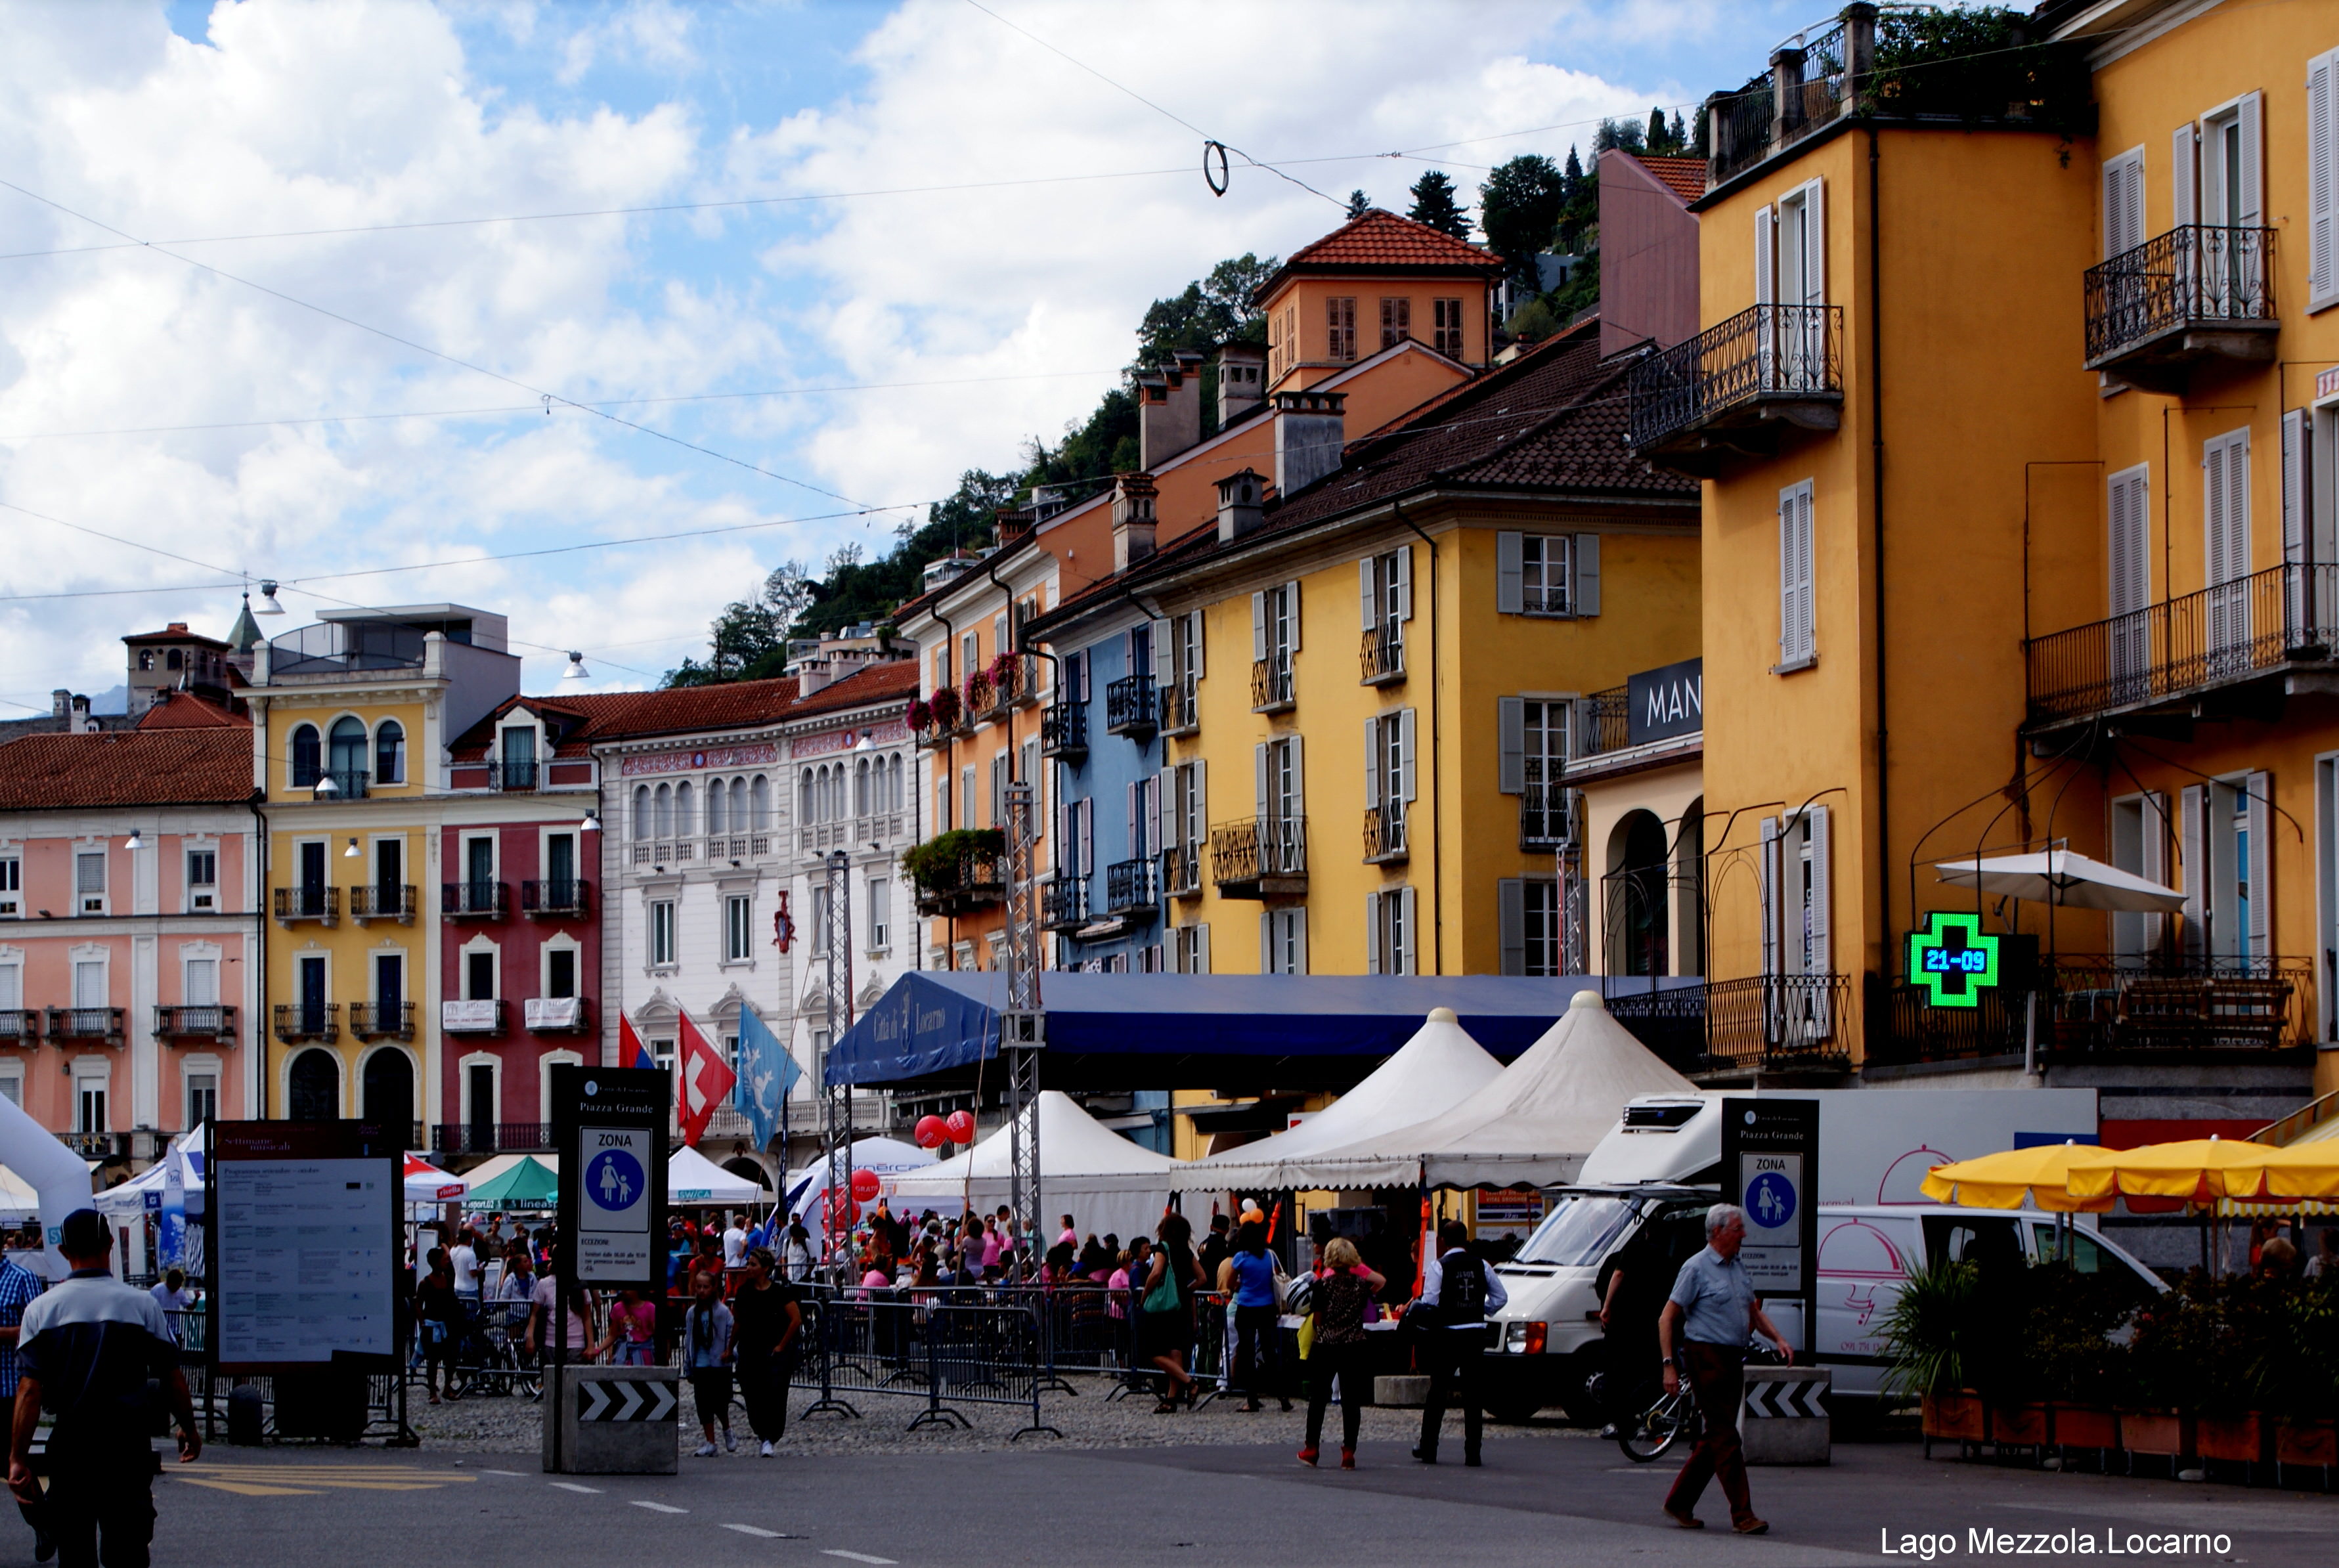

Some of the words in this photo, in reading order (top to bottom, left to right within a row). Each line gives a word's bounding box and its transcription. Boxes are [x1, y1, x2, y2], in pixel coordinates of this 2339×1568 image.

[1647, 674, 1701, 727] MAN
[1927, 949, 1984, 970] 21-09
[874, 1011, 889, 1043] Città
[890, 1008, 897, 1039] di
[915, 1003, 946, 1035] Locarno
[580, 1102, 612, 1112] Piazza
[617, 1103, 653, 1114] Grande
[598, 1134, 632, 1146] ZONA
[1740, 1129, 1768, 1139] Piazza
[1772, 1130, 1804, 1140] Grande
[1757, 1159, 1785, 1170] ZONA
[439, 1186, 461, 1196] rivella
[680, 1189, 710, 1198] SWICA
